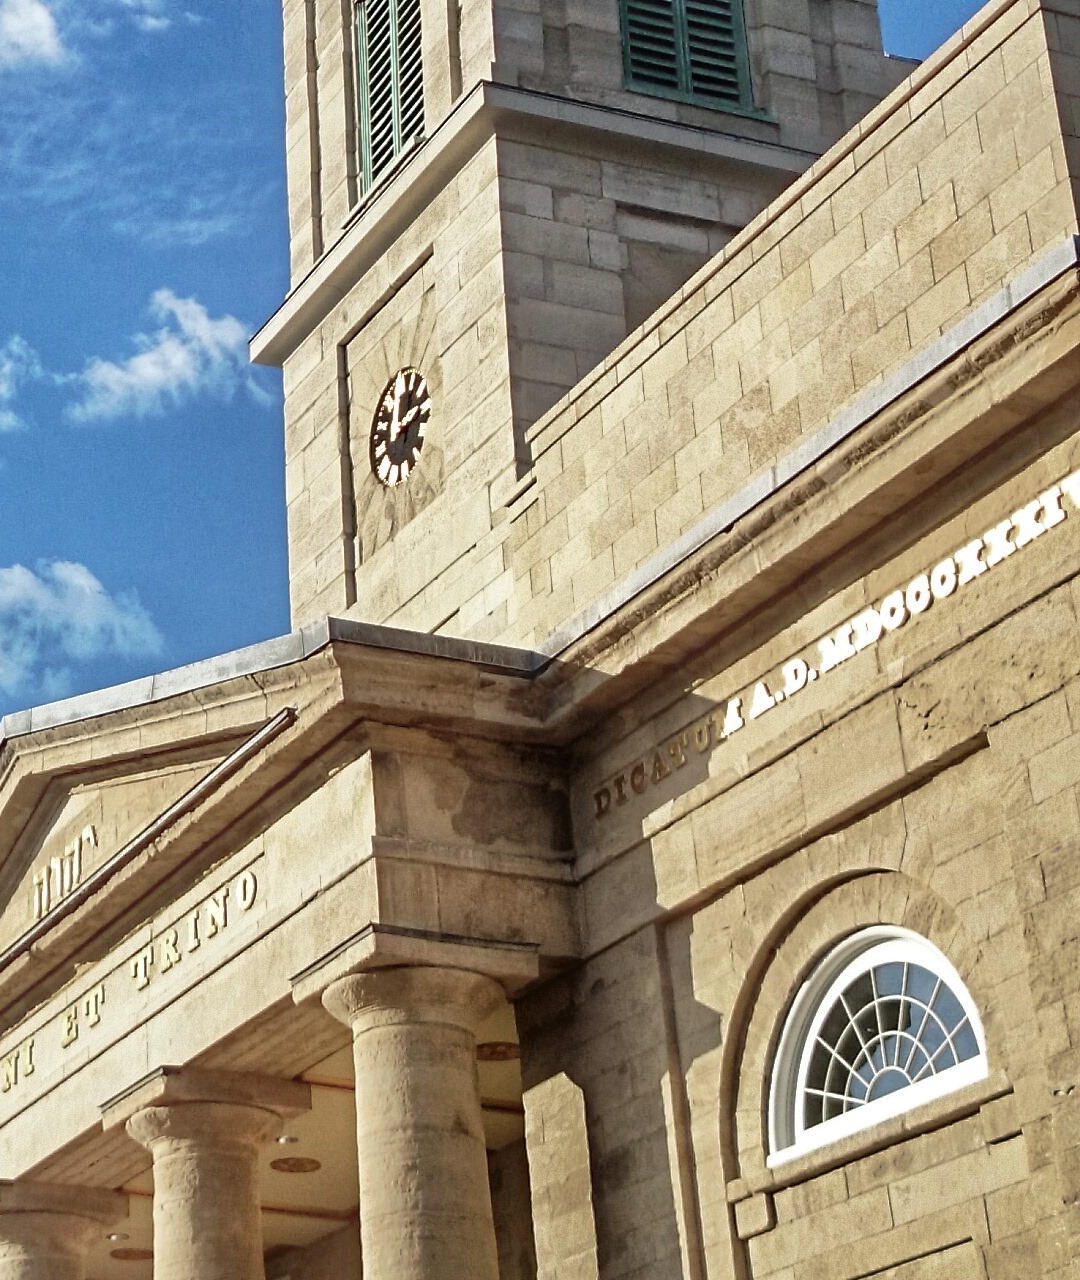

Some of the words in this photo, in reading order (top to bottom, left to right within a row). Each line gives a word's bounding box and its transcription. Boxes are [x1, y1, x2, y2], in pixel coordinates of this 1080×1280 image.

[594, 696, 746, 819] DICATUM
[61, 983, 106, 1049] ET
[130, 870, 258, 992] TRINO
